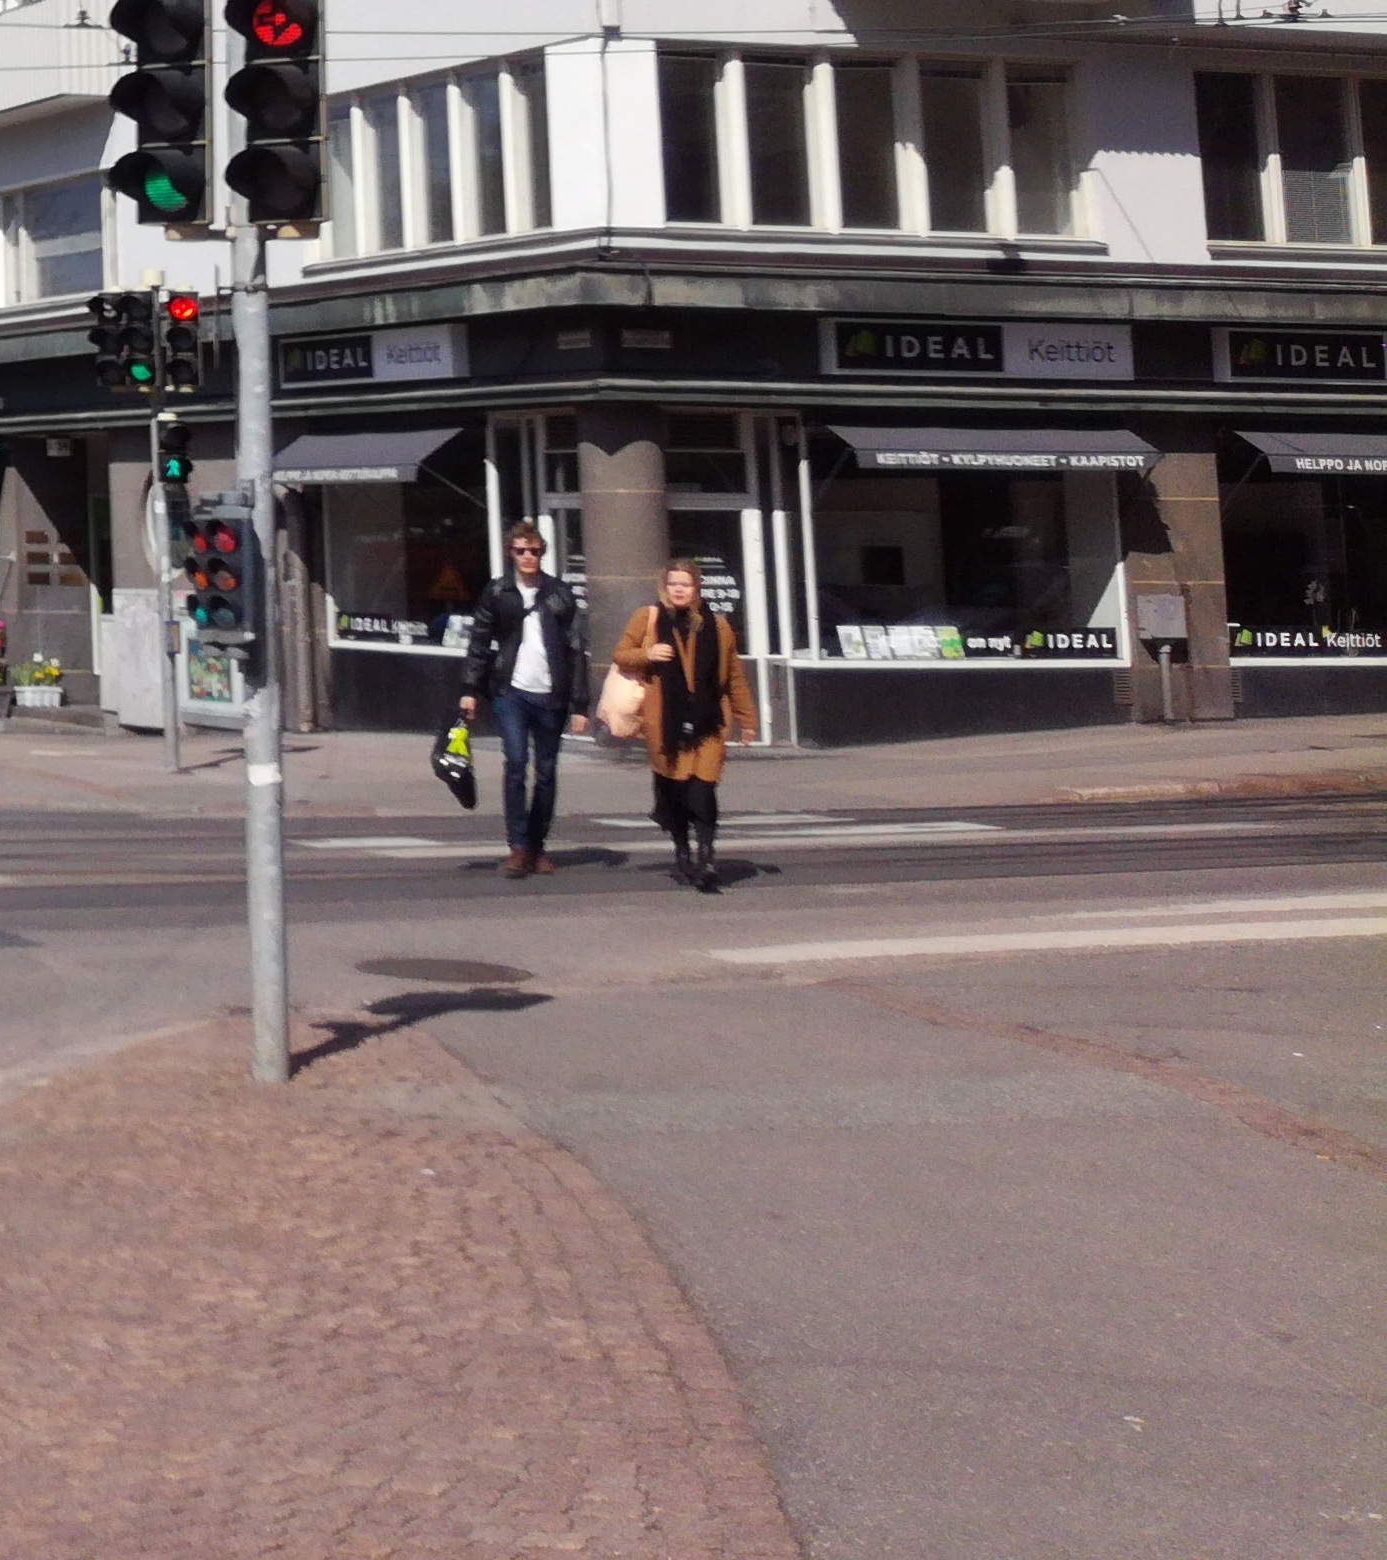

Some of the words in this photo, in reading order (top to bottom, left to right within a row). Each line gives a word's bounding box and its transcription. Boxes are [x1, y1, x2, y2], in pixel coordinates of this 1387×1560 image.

[885, 334, 995, 359] IDEAL
[1029, 339, 1115, 363] Keittiöt
[1276, 343, 1377, 368] IDEAL
[306, 347, 368, 371] IDEAL
[1069, 455, 1145, 468] KAAPISTOT
[1295, 458, 1344, 470] HELPPO
[1346, 459, 1363, 471] JA
[350, 617, 391, 633] IDEAL
[1047, 633, 1113, 649] IDEAL
[1256, 632, 1320, 647] IDEAL
[1327, 633, 1382, 648] Keittiöt
